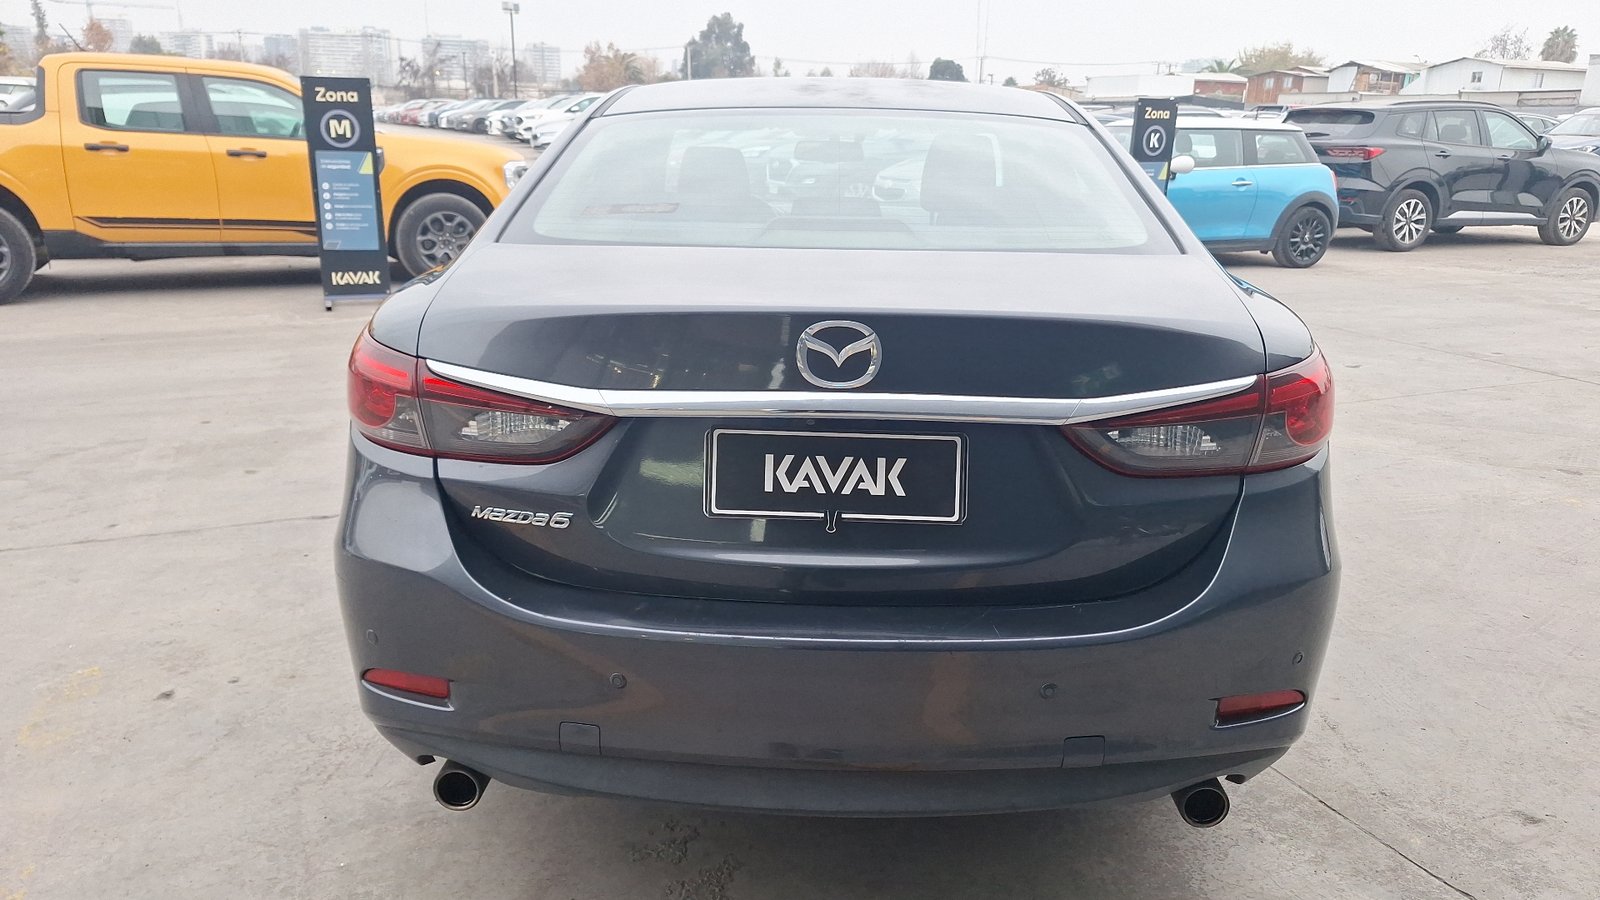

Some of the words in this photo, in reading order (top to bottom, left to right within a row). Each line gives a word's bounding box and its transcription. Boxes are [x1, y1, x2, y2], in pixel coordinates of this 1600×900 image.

[314, 86, 359, 103] Zona
[1144, 107, 1171, 120] Zona
[328, 118, 352, 139] M
[1149, 132, 1161, 149] K
[331, 270, 381, 286] KAVAK
[764, 453, 908, 497] KAVAK
